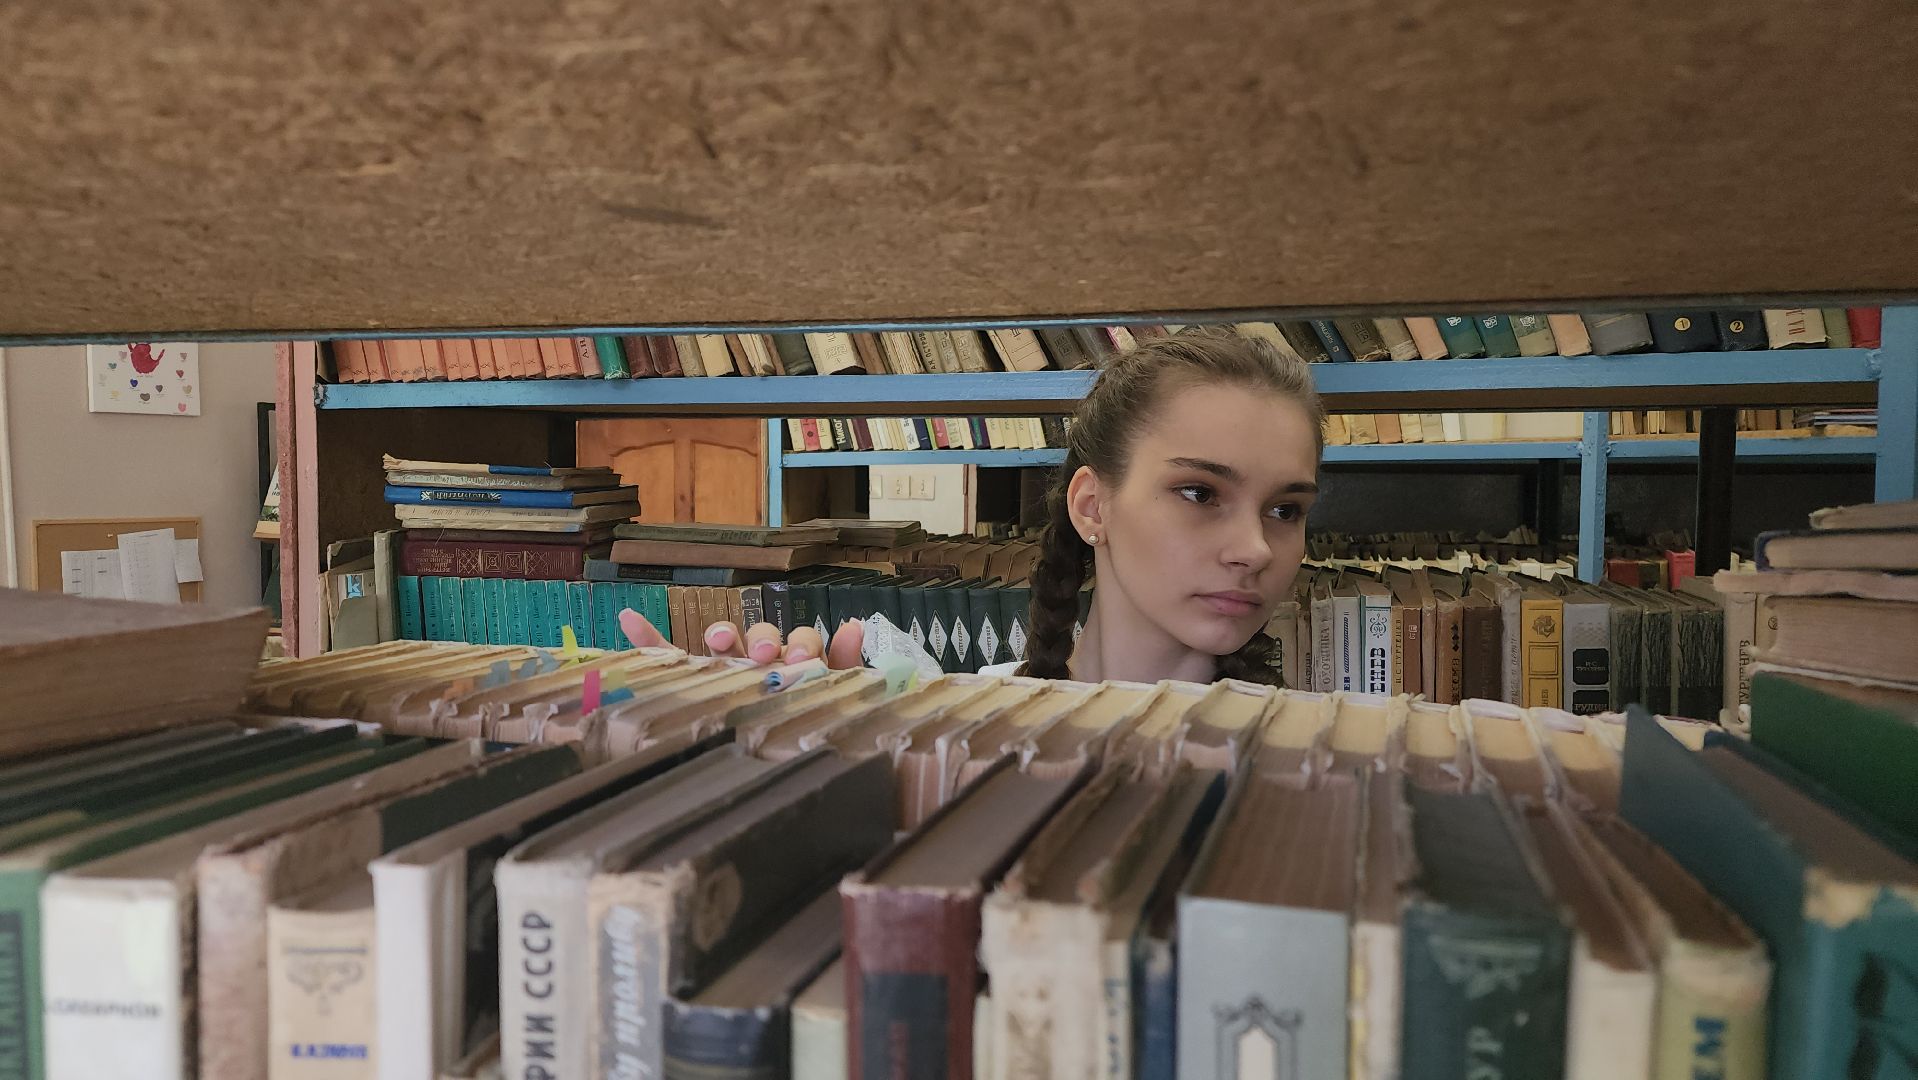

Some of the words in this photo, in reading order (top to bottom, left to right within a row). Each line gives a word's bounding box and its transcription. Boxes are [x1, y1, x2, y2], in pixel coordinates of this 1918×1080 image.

[1733, 321, 1742, 331] 2
[1369, 647, 1386, 695] ЕНЕВ
[522, 912, 554, 999] СССР
